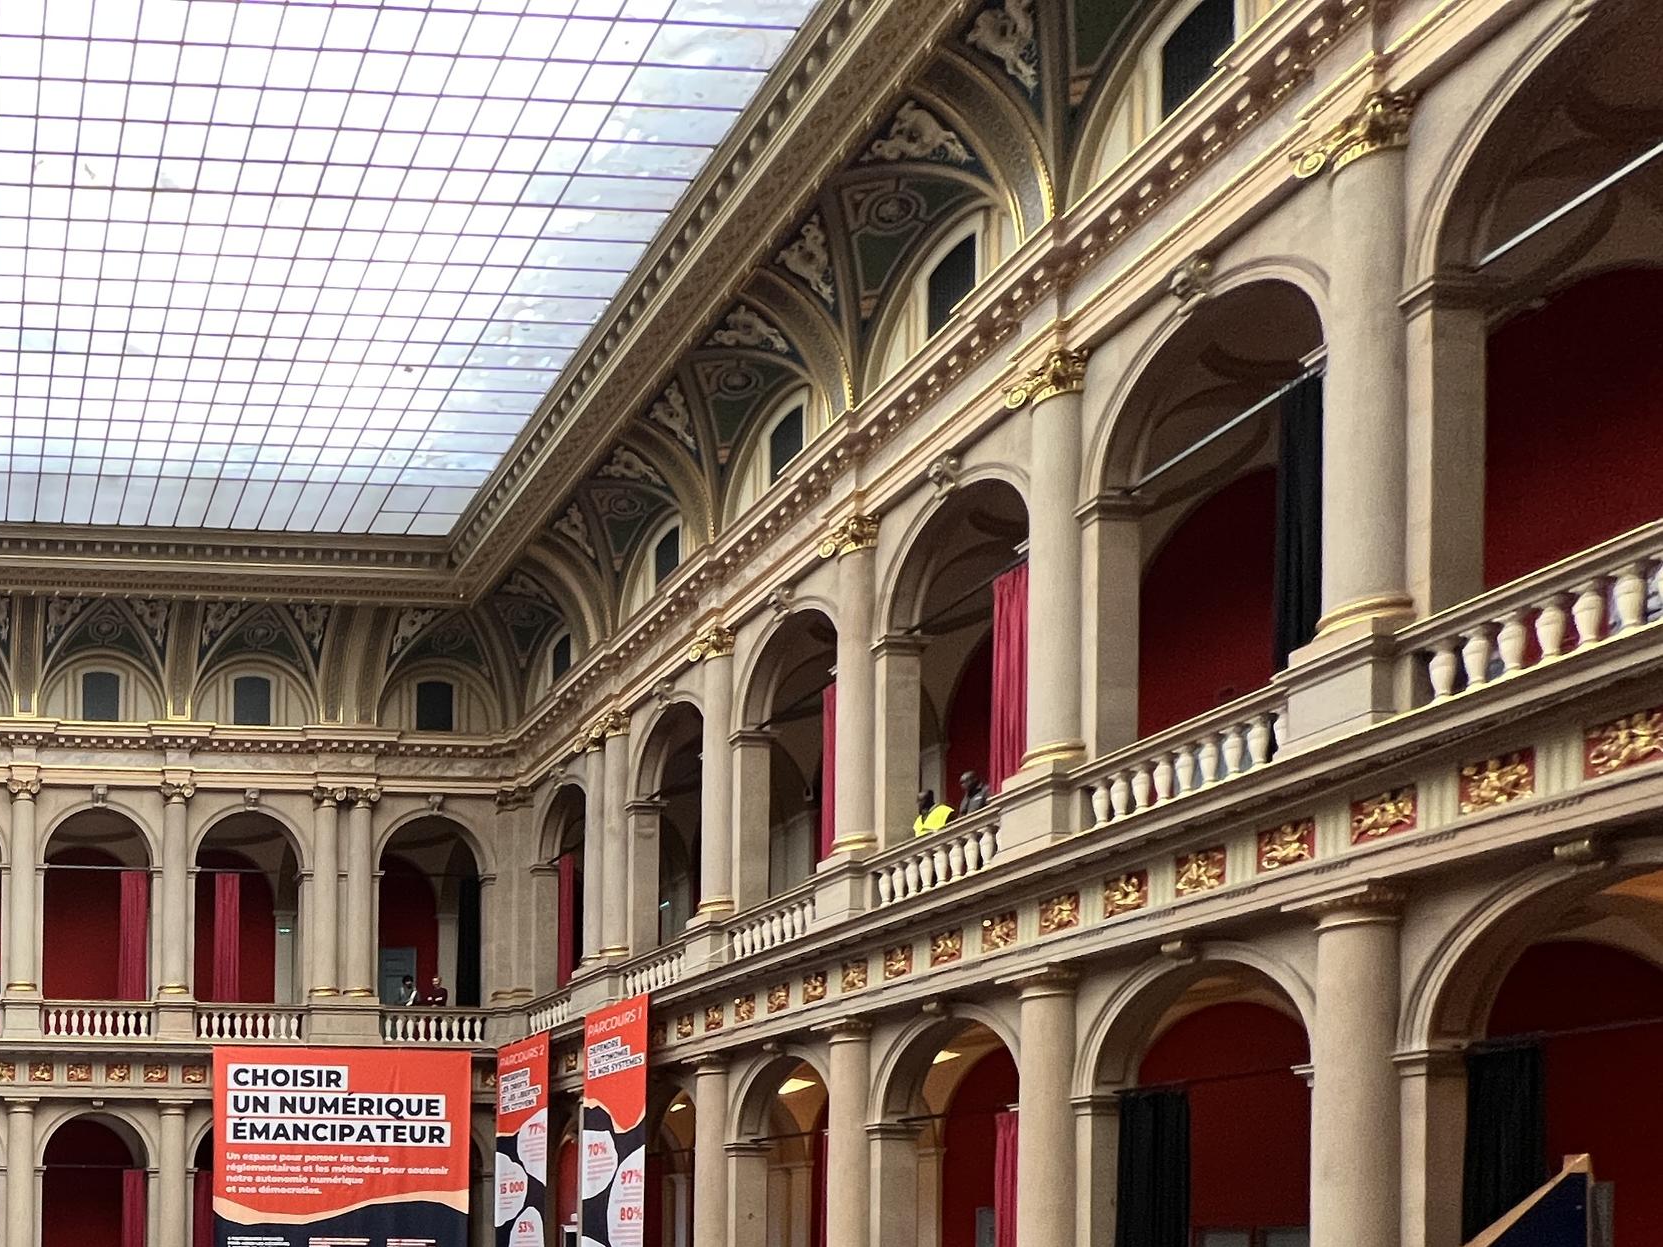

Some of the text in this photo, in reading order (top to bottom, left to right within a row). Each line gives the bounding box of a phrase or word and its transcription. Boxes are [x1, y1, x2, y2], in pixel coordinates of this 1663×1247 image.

[588, 1005, 643, 1037] PARCOURS 1
[500, 1044, 545, 1066] PARCOURS 2
[233, 1068, 342, 1088] CHOISIR
[233, 1092, 440, 1120] UN NUMÉRIQUE
[232, 1117, 445, 1144] ÉMANCIPATEUR
[528, 1121, 546, 1136] 77%
[587, 1142, 607, 1157] 70%
[226, 1152, 389, 1164] Un espace pour penser les cadres
[226, 1164, 448, 1176] réglementaires et les méthodes pour soutenir
[621, 1169, 643, 1185] 97%
[226, 1174, 363, 1185] notre autonomie numérique
[226, 1185, 322, 1195] et nos démocraties.
[620, 1206, 643, 1221] 80%
